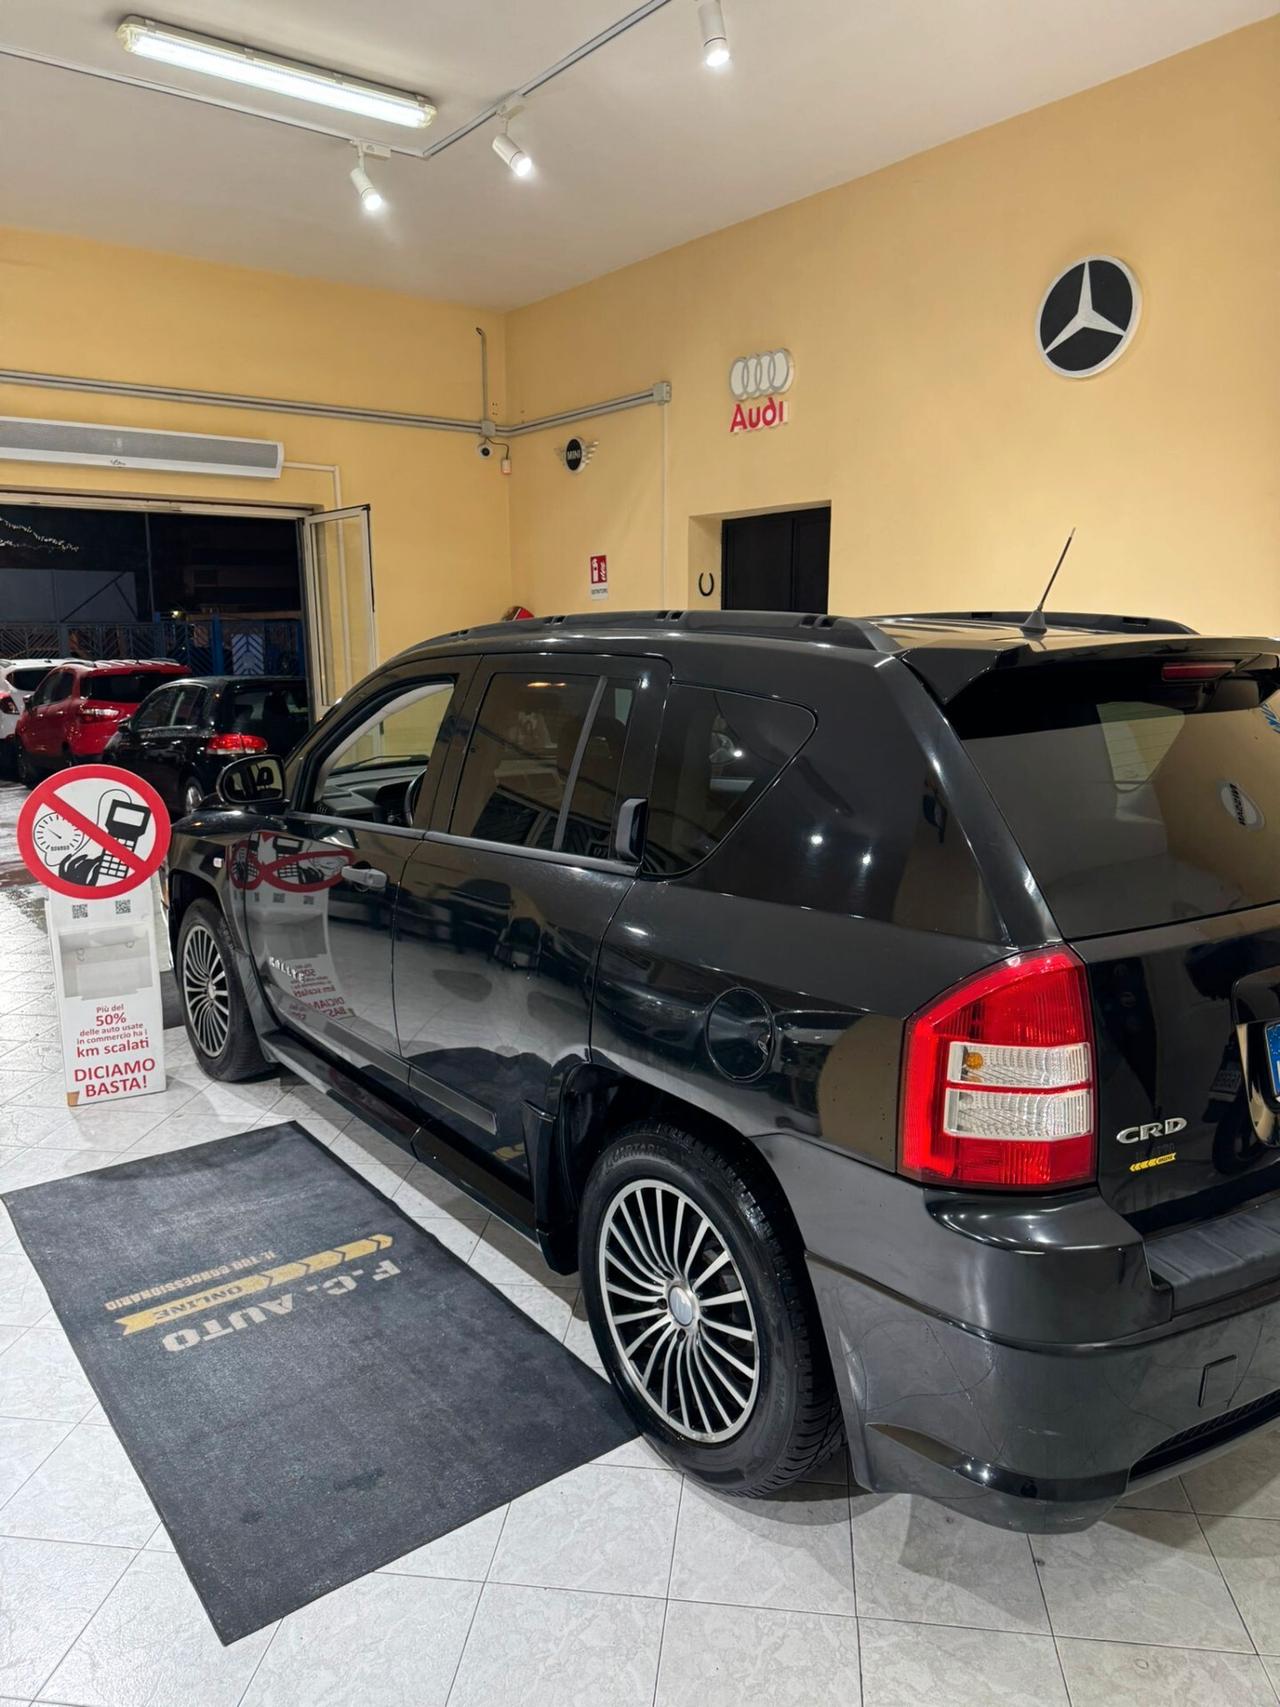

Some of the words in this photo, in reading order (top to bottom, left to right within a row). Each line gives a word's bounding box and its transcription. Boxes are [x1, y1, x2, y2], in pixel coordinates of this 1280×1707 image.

[729, 397, 784, 433] Audi
[566, 449, 581, 460] MINI
[96, 1012, 127, 1026] 50%
[111, 1004, 124, 1012] del
[80, 1029, 100, 1037] delle
[101, 1026, 120, 1034] auto
[122, 1023, 144, 1031] usate
[87, 1032, 131, 1044] commercio
[133, 1030, 143, 1038] ha
[76, 1046, 100, 1058] km
[104, 1037, 149, 1055] scalati
[74, 1058, 155, 1082] DICIAMO
[85, 1074, 147, 1097] BASTA!
[1116, 1117, 1188, 1144] CRD
[153, 1285, 243, 1321] ONLINE
[161, 1293, 293, 1352] AUTO
